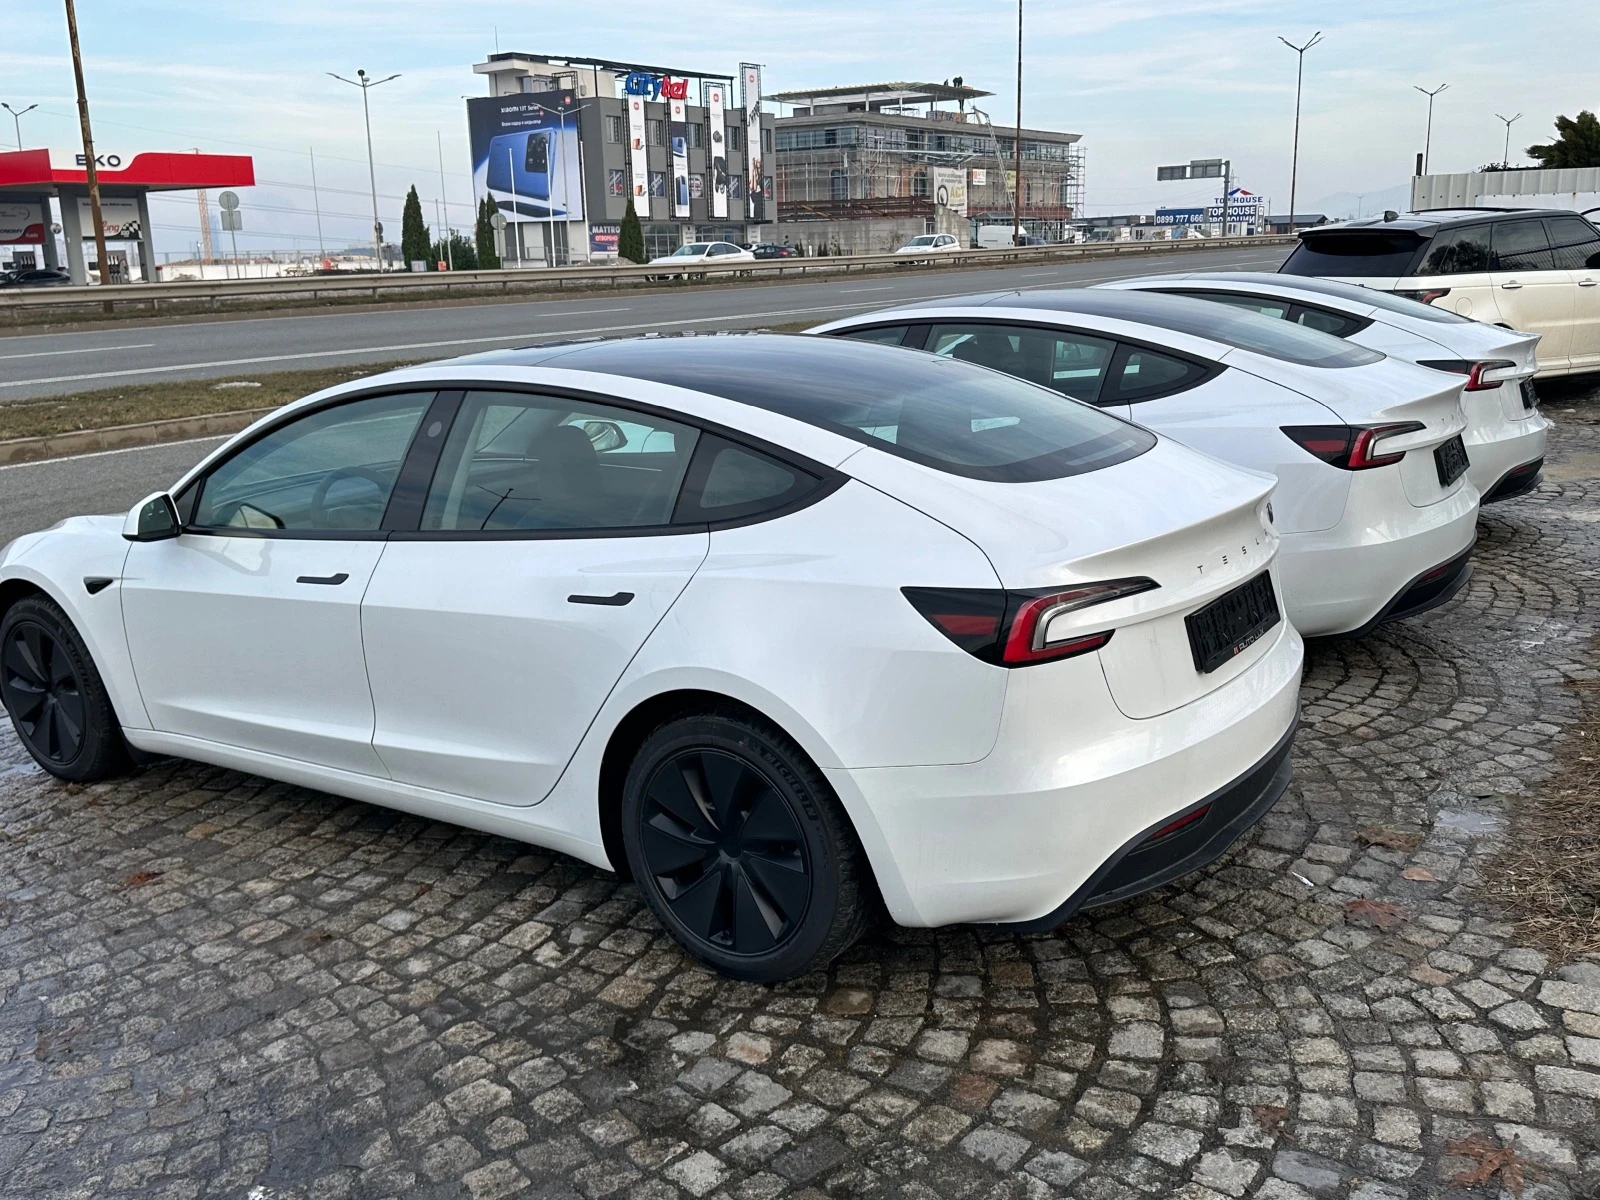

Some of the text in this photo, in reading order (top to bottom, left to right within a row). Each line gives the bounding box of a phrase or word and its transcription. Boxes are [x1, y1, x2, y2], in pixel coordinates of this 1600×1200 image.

[625, 73, 688, 101] Citytel
[75, 154, 121, 167] EKO
[1233, 196, 1264, 204] HOUSE
[1208, 206, 1256, 216] TOP HOUSE
[1156, 213, 1204, 224] 0899 777 666
[592, 225, 621, 234] MATTRO
[763, 751, 820, 821] MICHELIN
